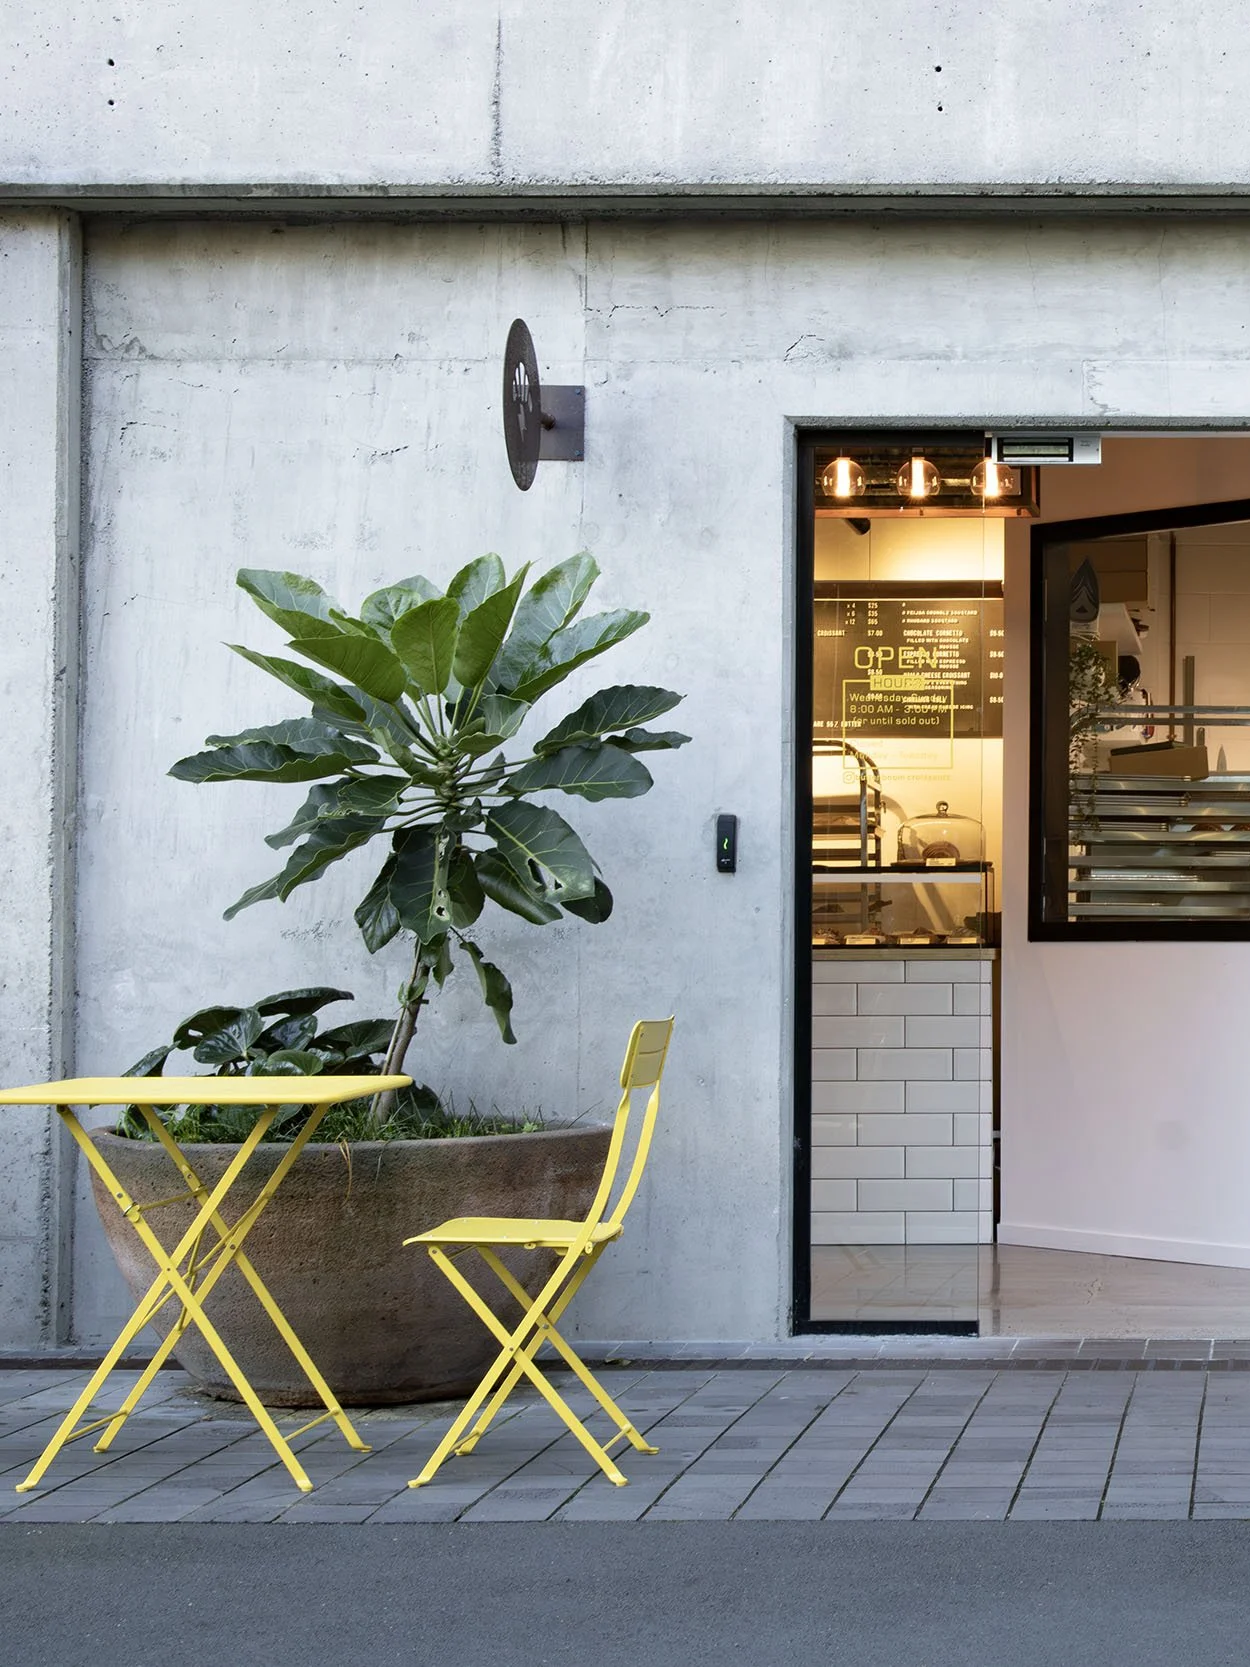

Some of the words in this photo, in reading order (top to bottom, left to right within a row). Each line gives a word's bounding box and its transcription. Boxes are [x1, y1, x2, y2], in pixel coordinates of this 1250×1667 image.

[816, 629, 845, 637] CROISSANT
[867, 629, 883, 637] $7.00
[903, 629, 933, 637] CHOCOLATE
[854, 646, 938, 669] OPEN
[849, 704, 875, 714] 8:00
[876, 705, 894, 714] AM
[870, 716, 893, 725] until
[895, 716, 916, 725] sold
[918, 716, 940, 725] out)
